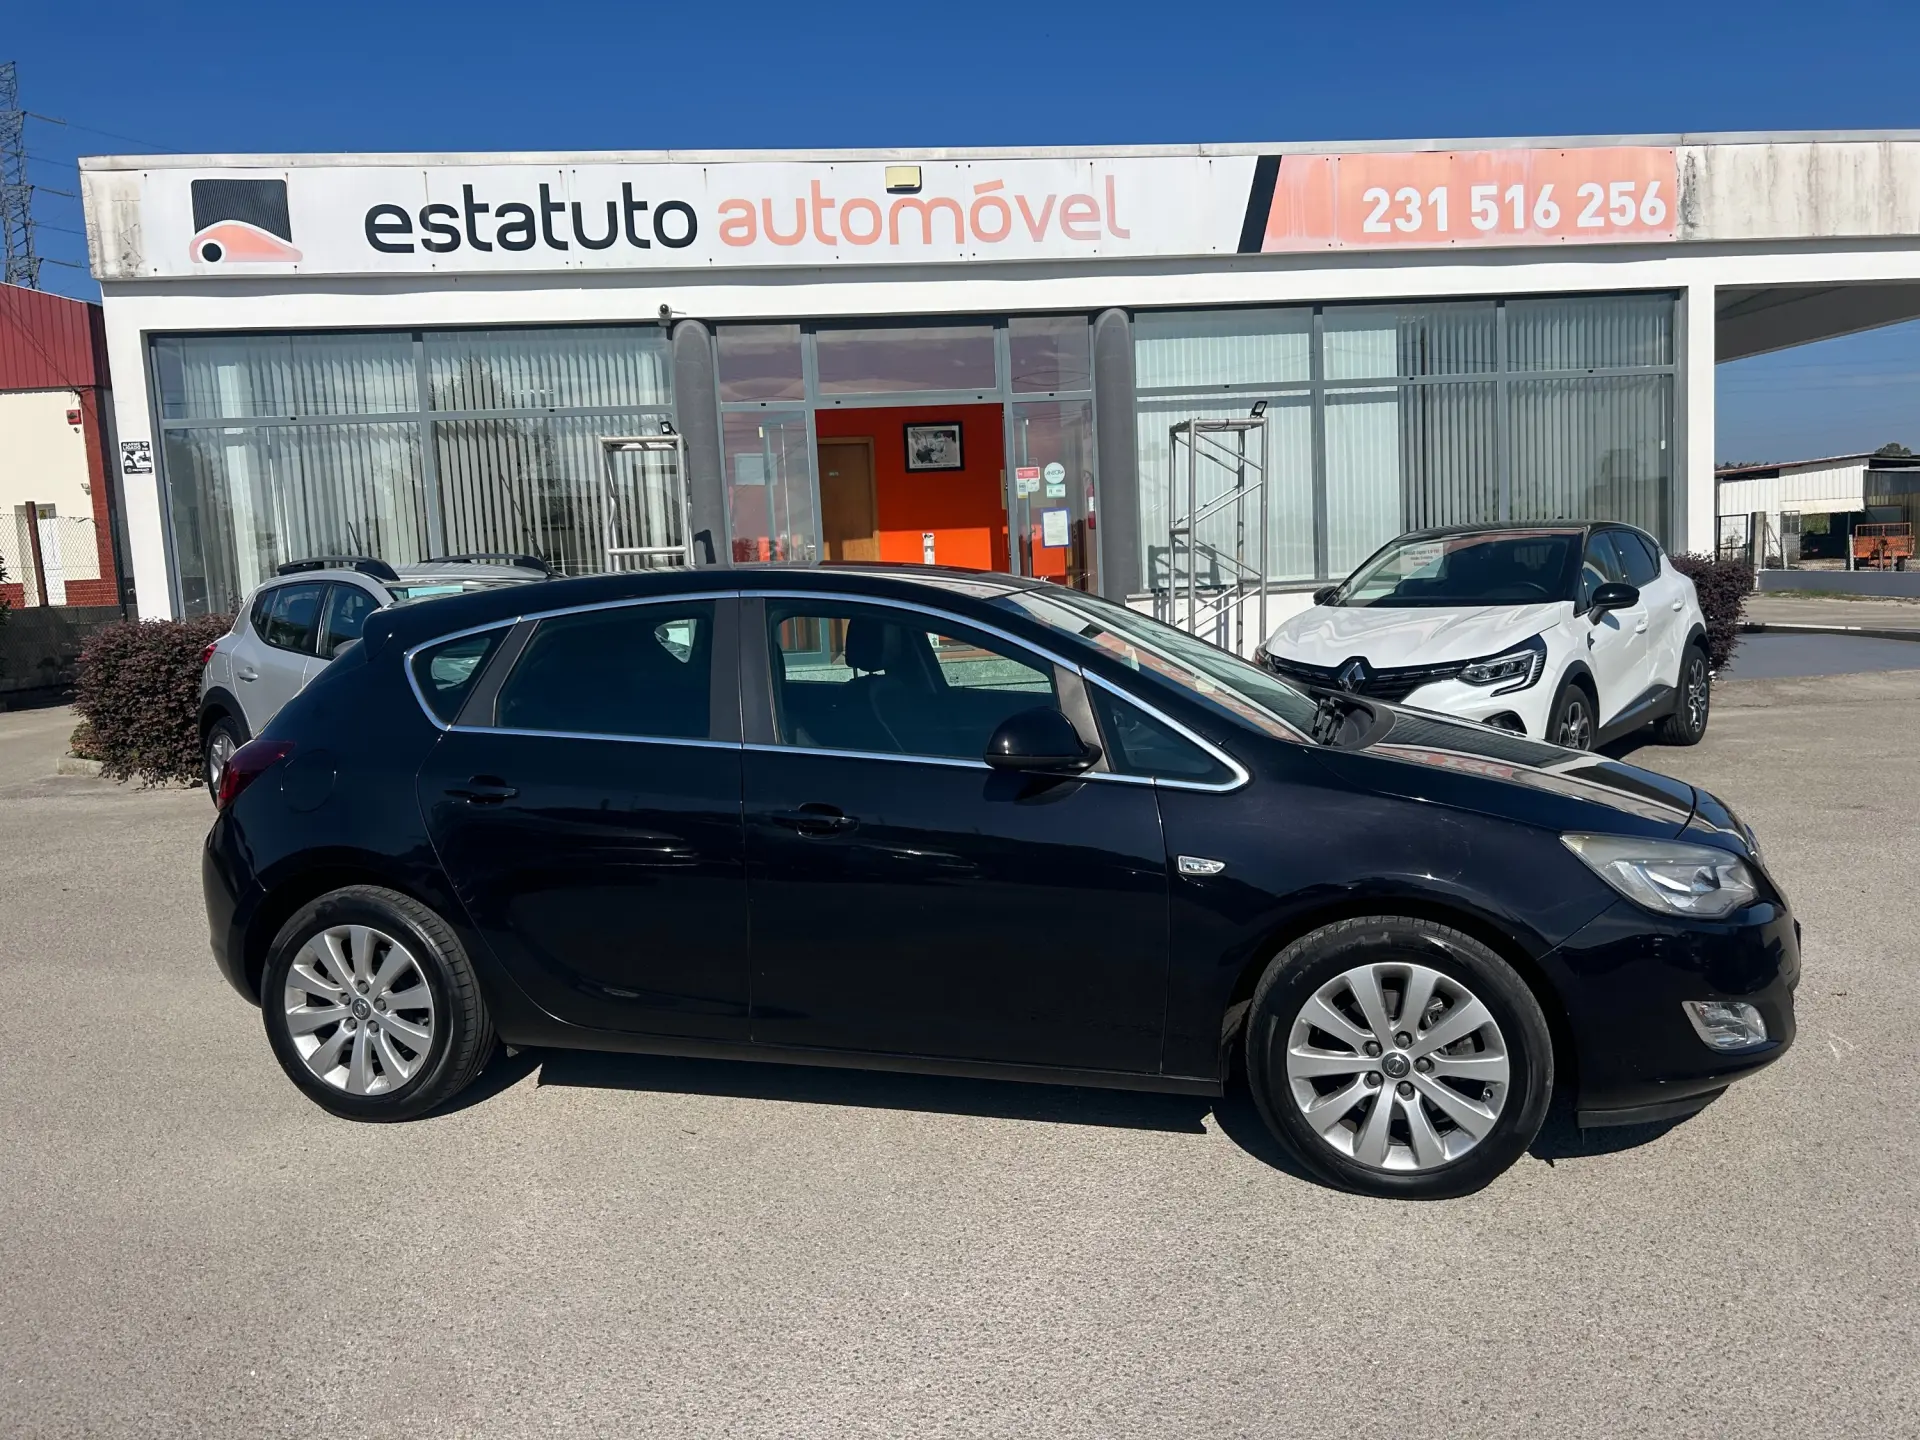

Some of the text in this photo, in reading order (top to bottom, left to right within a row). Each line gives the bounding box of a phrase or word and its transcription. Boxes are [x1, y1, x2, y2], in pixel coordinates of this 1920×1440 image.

[364, 174, 1131, 254] estatuto automóvel
[1362, 181, 1667, 233] 231 516 256
